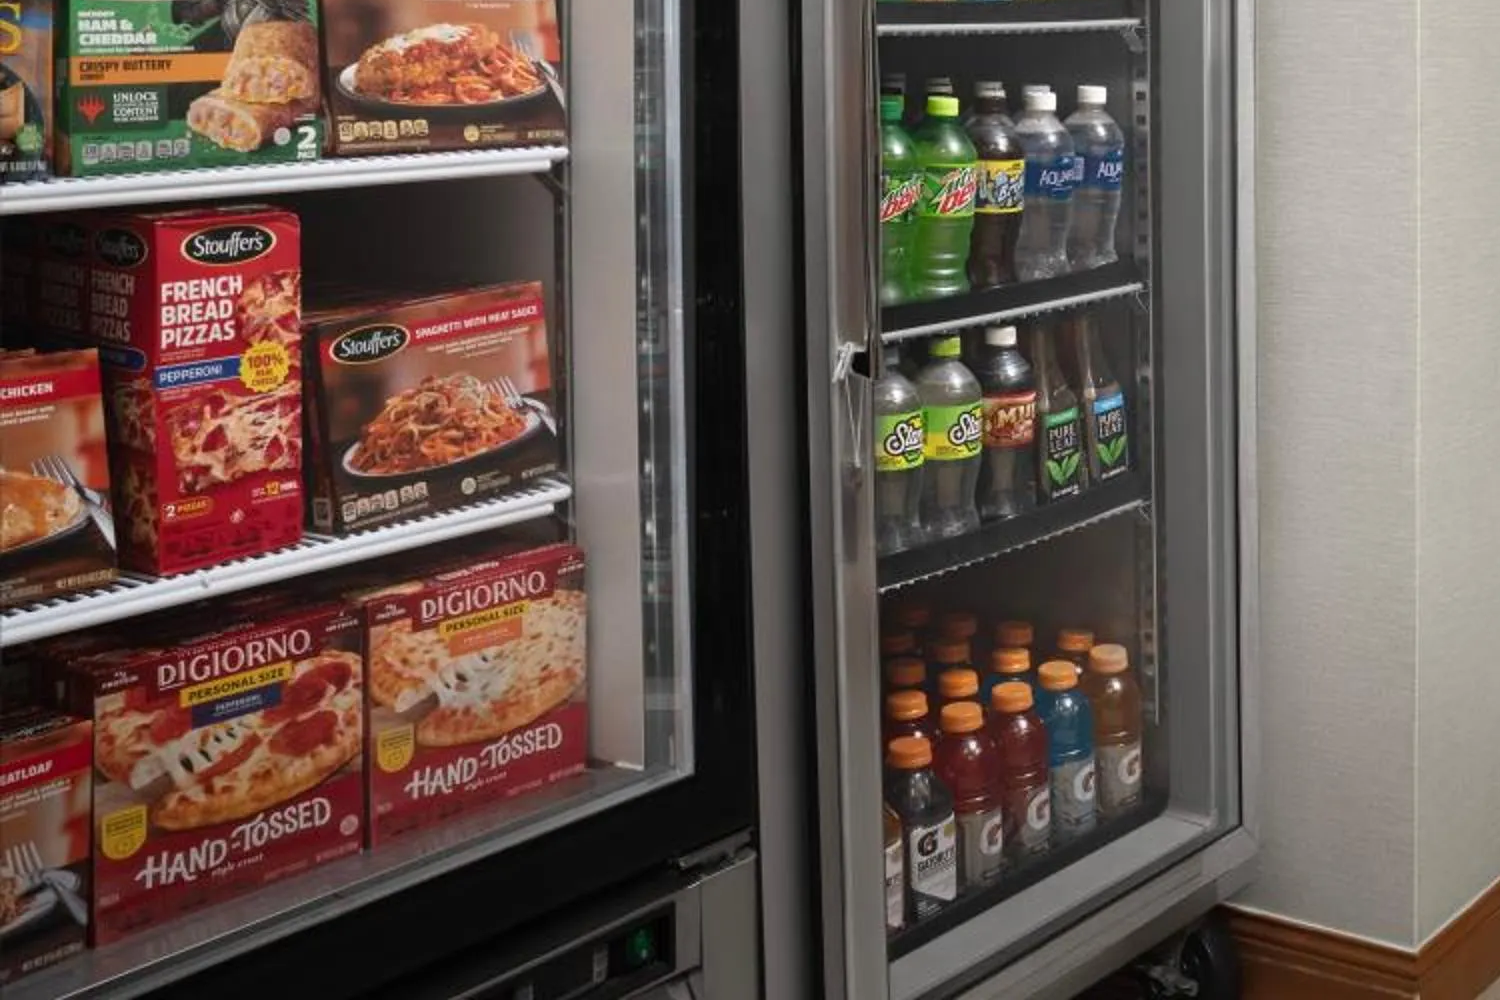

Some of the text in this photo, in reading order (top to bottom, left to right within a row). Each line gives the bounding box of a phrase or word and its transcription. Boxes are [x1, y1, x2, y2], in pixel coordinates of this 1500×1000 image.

[77, 18, 118, 31] HAM
[78, 31, 158, 45] CHEDDAR
[79, 58, 173, 75] CRISPY BUTTERY
[113, 91, 159, 103] UNLOCK
[113, 106, 159, 118] CONTENT
[297, 125, 318, 150] 2
[192, 231, 264, 258] Stouffer's
[160, 273, 243, 304] FRENCH
[160, 299, 234, 327] BREAD
[160, 320, 236, 351] PIZZAS
[339, 330, 401, 358] Stouffer's
[0, 380, 54, 398] CHICKEN
[158, 365, 224, 386] PEPPERONI
[420, 570, 548, 620] DIGIORNO
[445, 603, 526, 633] PERSONAL SIZE
[156, 628, 313, 687] DIGIORNO
[188, 666, 286, 701] PERSONAL SIZE
[134, 797, 332, 889] HAND-TOSSED
